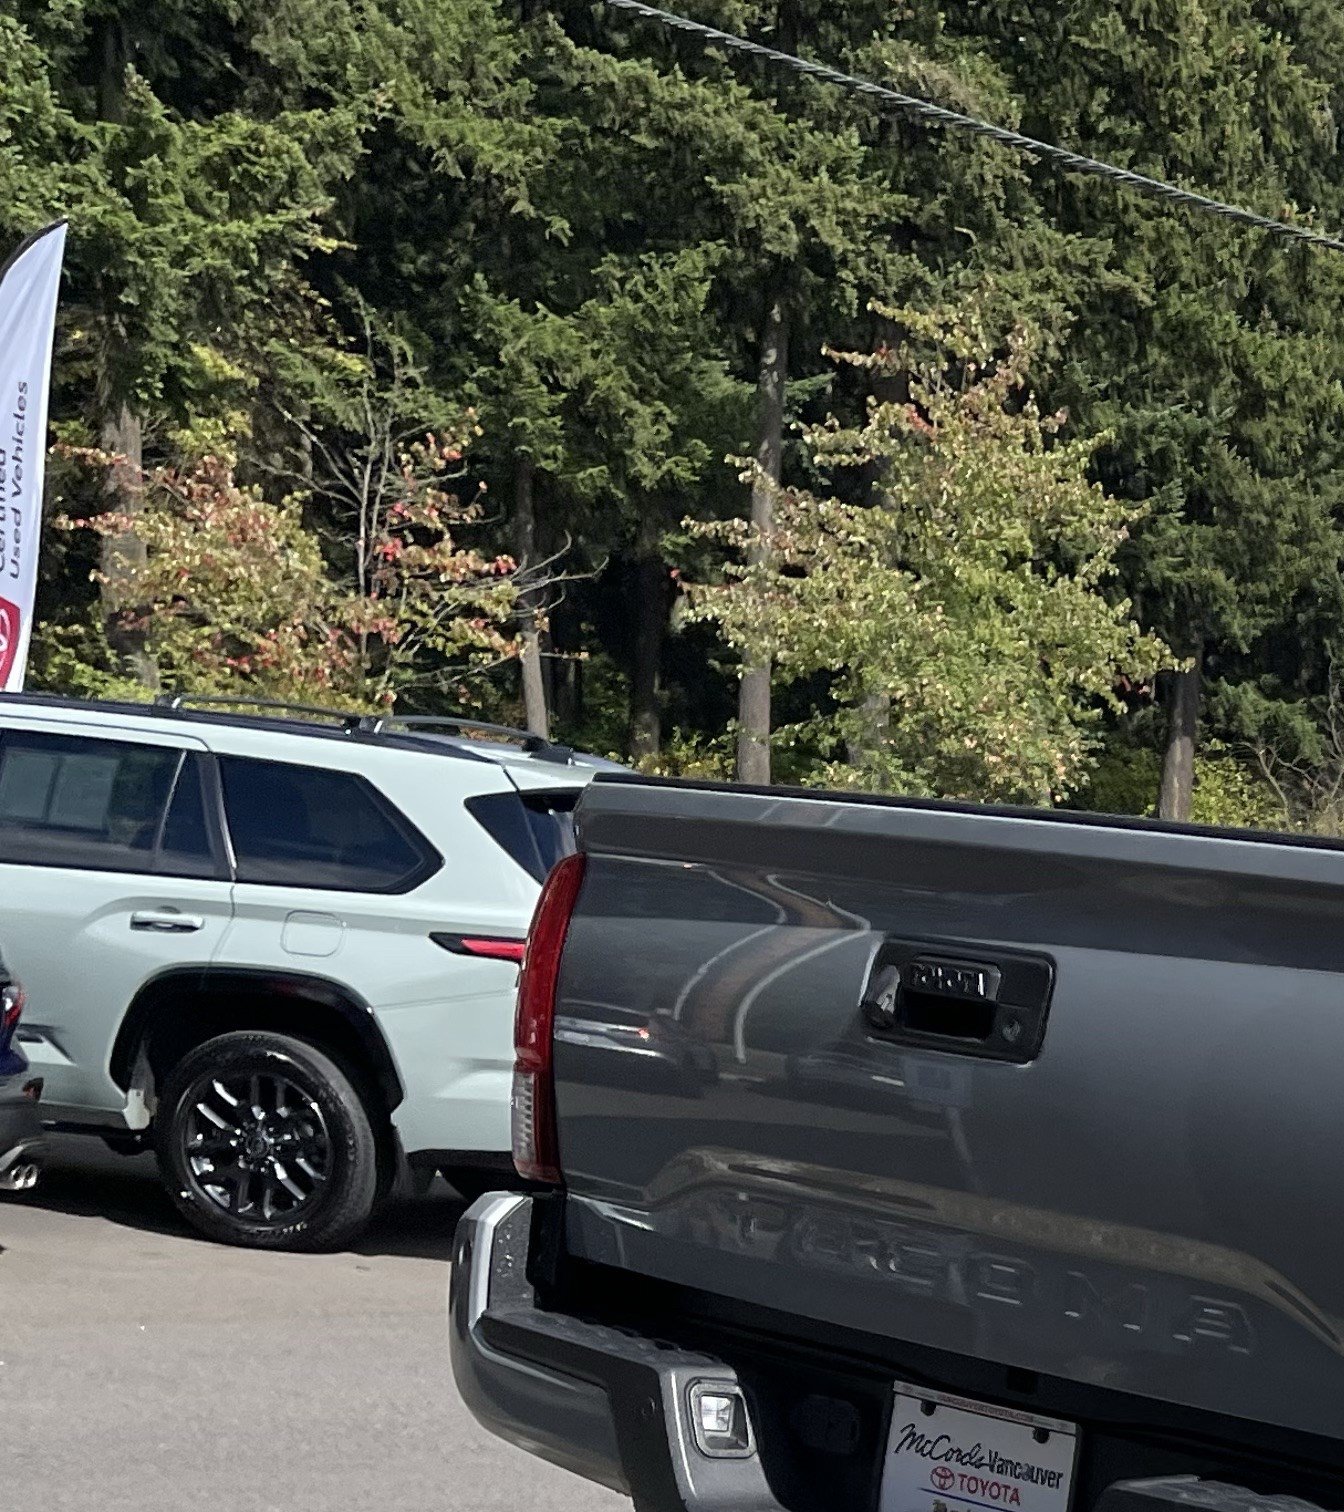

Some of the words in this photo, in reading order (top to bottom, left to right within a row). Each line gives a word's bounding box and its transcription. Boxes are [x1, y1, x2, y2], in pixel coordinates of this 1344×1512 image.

[11, 380, 28, 498] Vehicles
[10, 507, 22, 580] Used
[957, 1472, 1022, 1506] TOYOTA
[987, 1449, 1064, 1490] Vancouver
